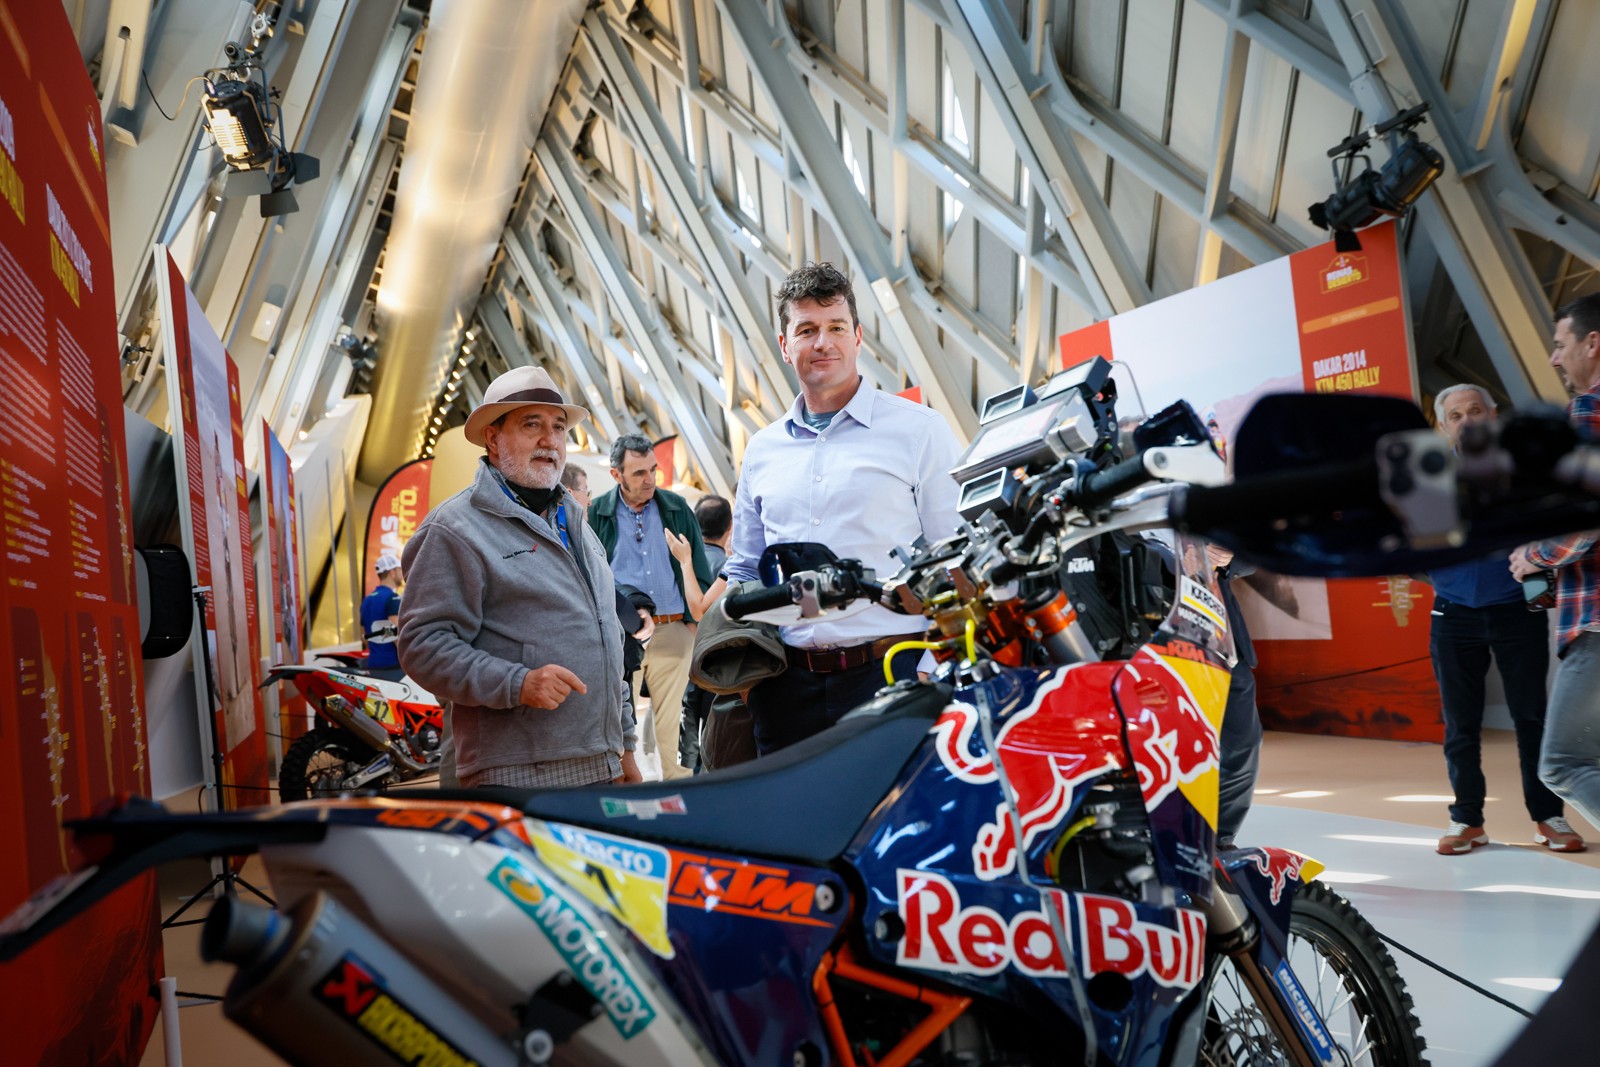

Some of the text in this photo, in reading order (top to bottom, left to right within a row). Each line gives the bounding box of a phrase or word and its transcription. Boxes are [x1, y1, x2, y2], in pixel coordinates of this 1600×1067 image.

[1313, 349, 1367, 379] DAKAR 2014
[1335, 372, 1353, 391] 450
[1353, 366, 1380, 389] RALLY
[1067, 557, 1095, 574] KTM
[1168, 639, 1206, 664] KTM
[673, 858, 817, 916] KTM
[899, 869, 1206, 988] Red Bull
[536, 894, 650, 1033] MOTOREX
[1279, 968, 1329, 1048] MICHELIN
